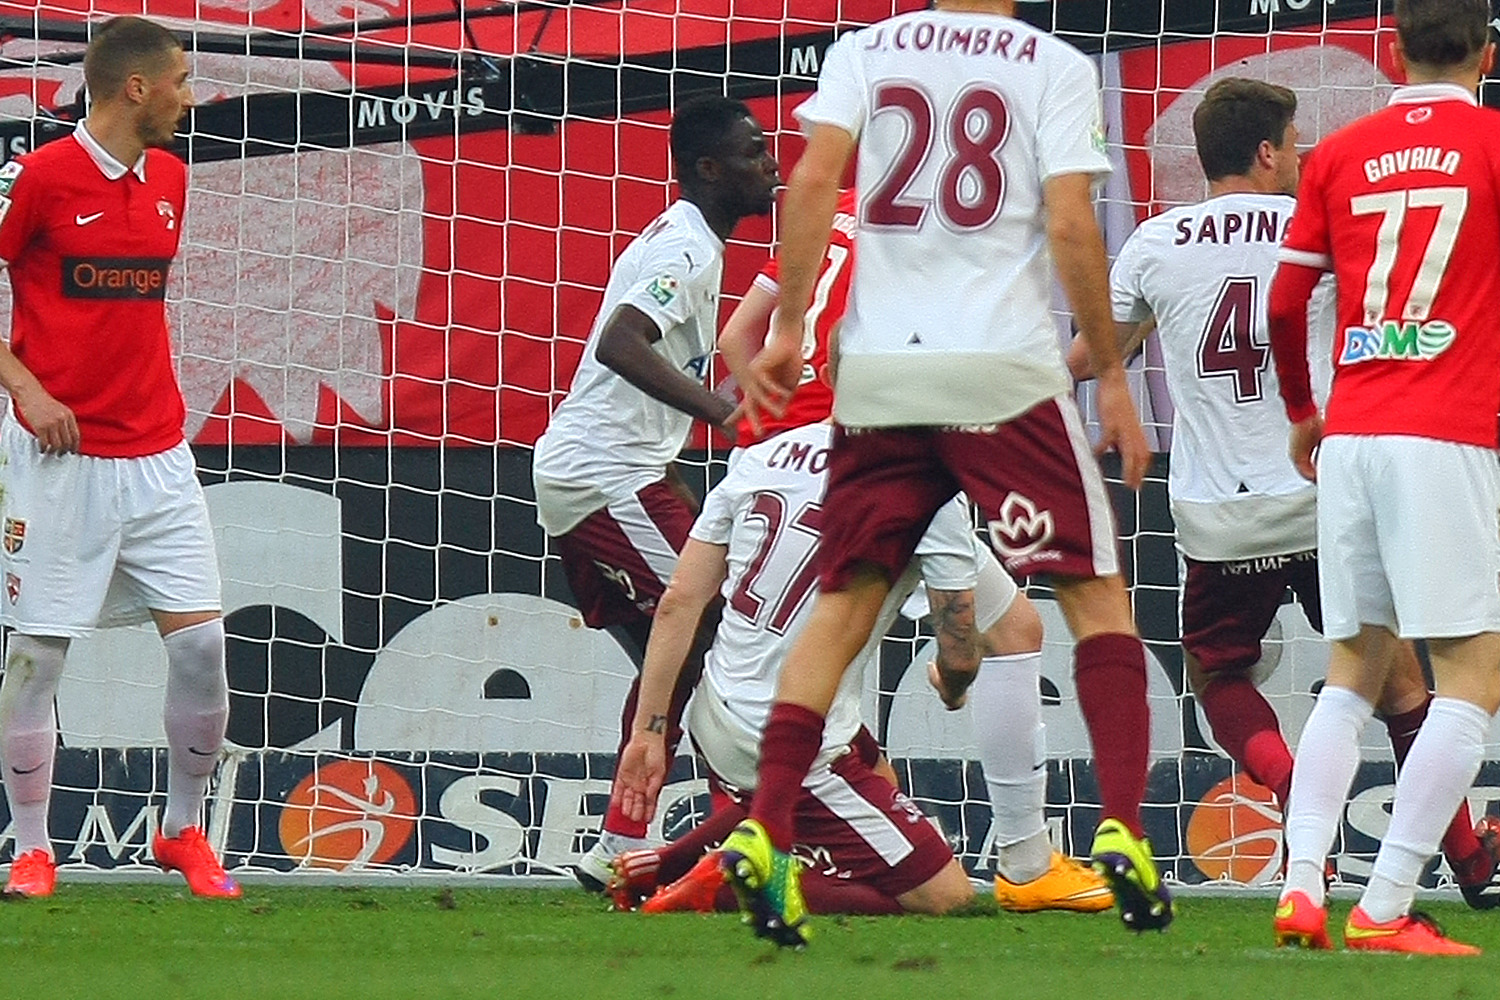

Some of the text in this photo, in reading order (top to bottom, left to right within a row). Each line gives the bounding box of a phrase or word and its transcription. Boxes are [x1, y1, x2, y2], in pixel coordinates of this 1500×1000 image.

[356, 87, 486, 128] MOVIS
[858, 78, 1013, 233] 28
[1364, 146, 1462, 183] GAVRILA
[73, 262, 161, 295] Orange
[1350, 186, 1468, 327] 77
[1197, 275, 1270, 404] 4
